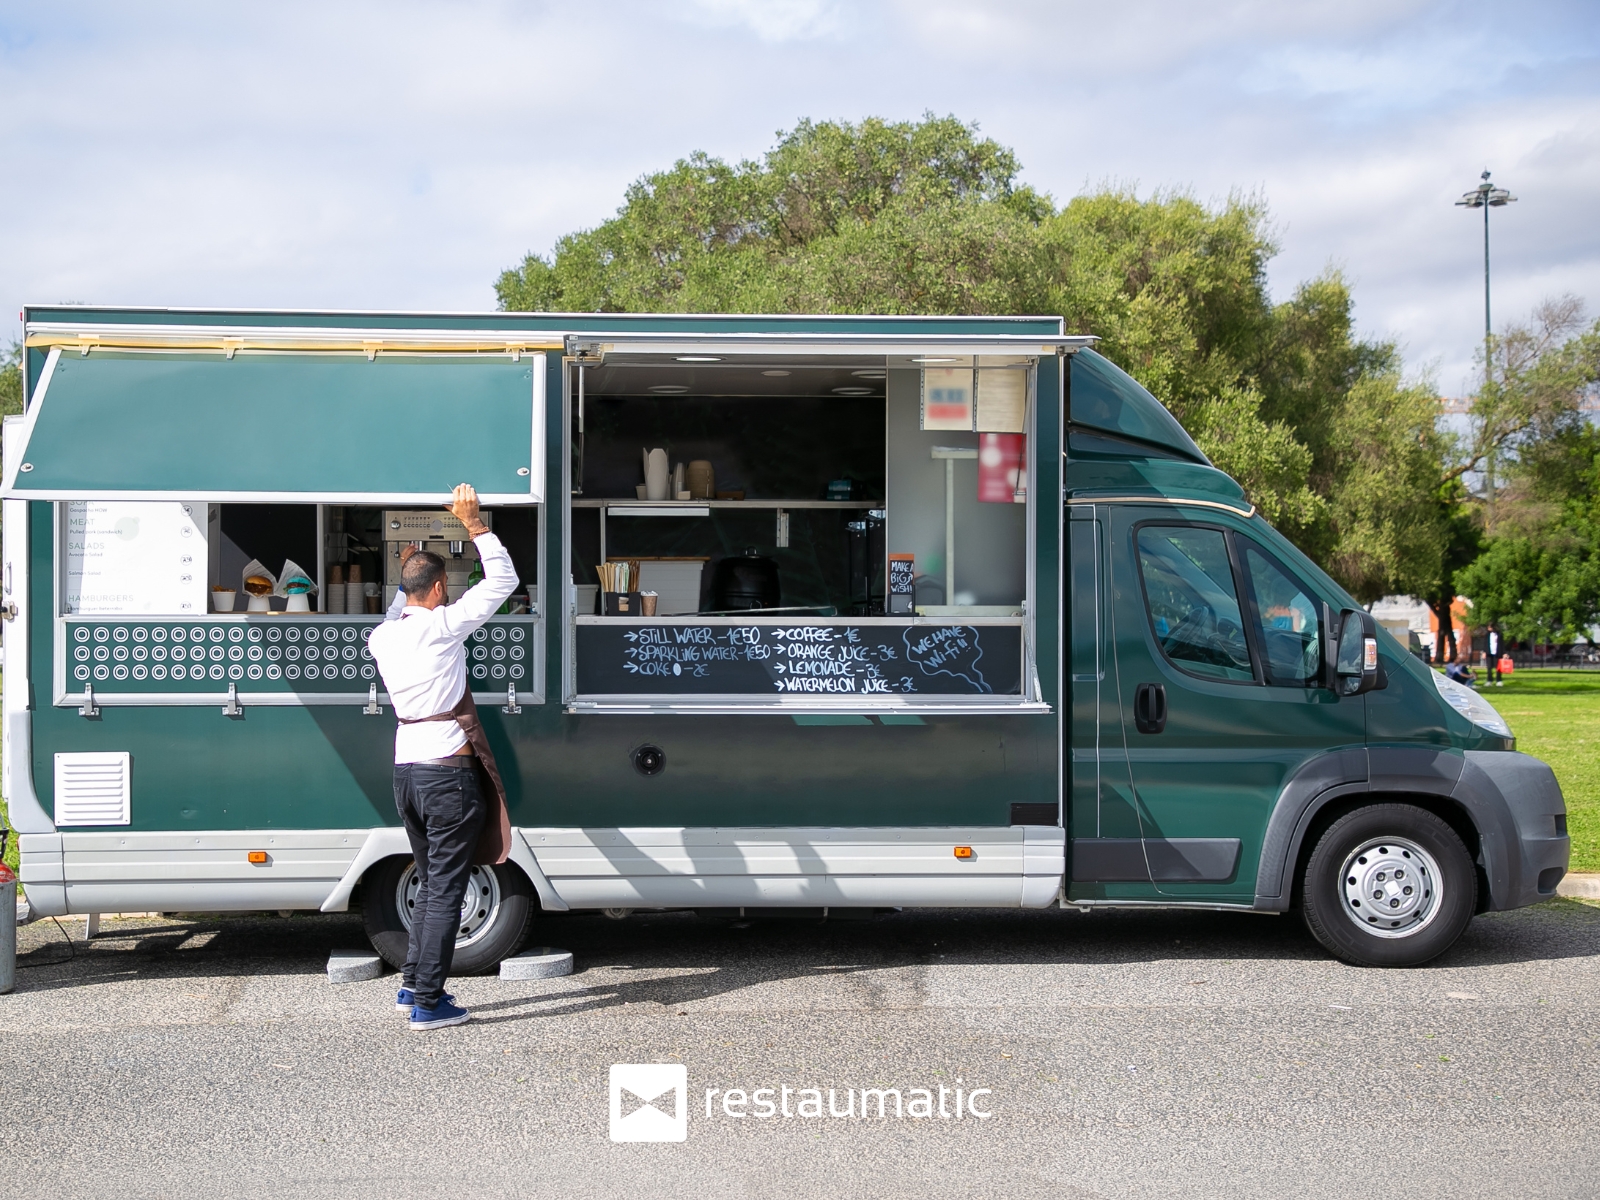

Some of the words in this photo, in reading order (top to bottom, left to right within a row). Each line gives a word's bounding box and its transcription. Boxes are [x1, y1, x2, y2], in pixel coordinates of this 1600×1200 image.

[69, 518, 95, 526] MEAT
[68, 542, 105, 550] SALADS
[891, 561, 910, 572] MAKE
[68, 594, 134, 602] HAMBURGERS
[673, 627, 717, 645] WATER
[785, 626, 834, 643] COFFEE
[911, 636, 936, 655] WE
[931, 626, 967, 644] HAVE
[701, 646, 739, 660] WATER
[787, 643, 835, 660] ORANGE
[639, 661, 671, 677] COKE
[788, 660, 855, 677] LEMONADE
[784, 676, 856, 692] WATERMELON
